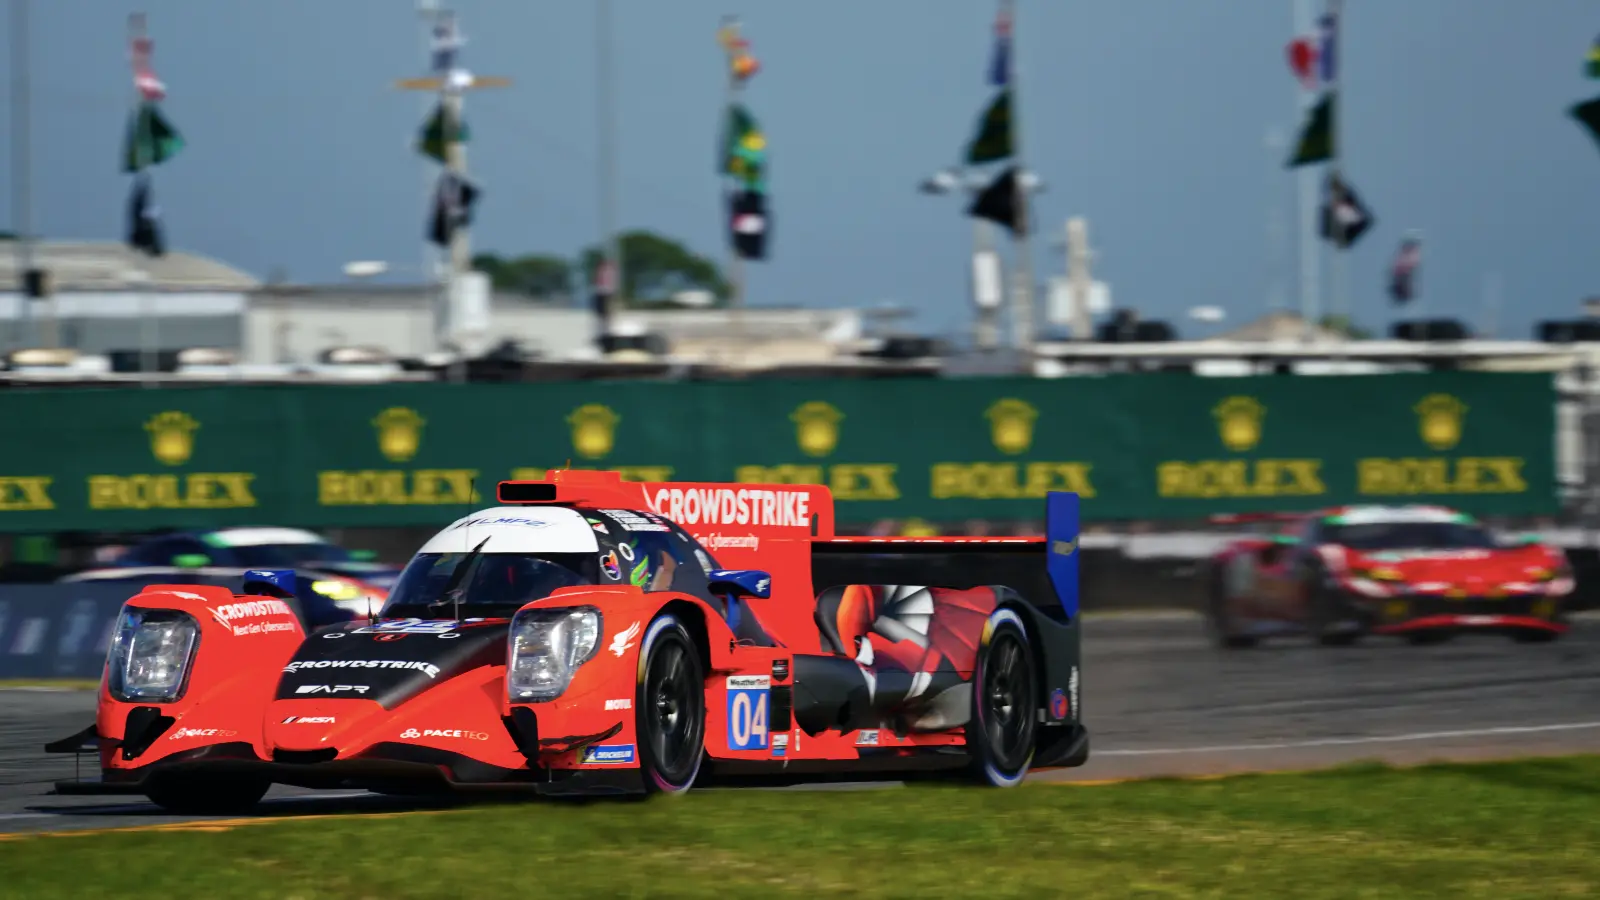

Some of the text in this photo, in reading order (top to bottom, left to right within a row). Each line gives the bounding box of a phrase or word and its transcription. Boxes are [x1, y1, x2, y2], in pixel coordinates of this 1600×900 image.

[88, 472, 257, 509] ROLEX
[318, 469, 481, 505] ROLEX
[931, 462, 1096, 499] ROLEX
[1157, 459, 1327, 497] ROLEX
[1357, 457, 1528, 495] ROLEX
[654, 488, 810, 527] CROWDSTRIKE
[287, 660, 440, 679] CROWDSTRIKE
[731, 691, 767, 747] 04
